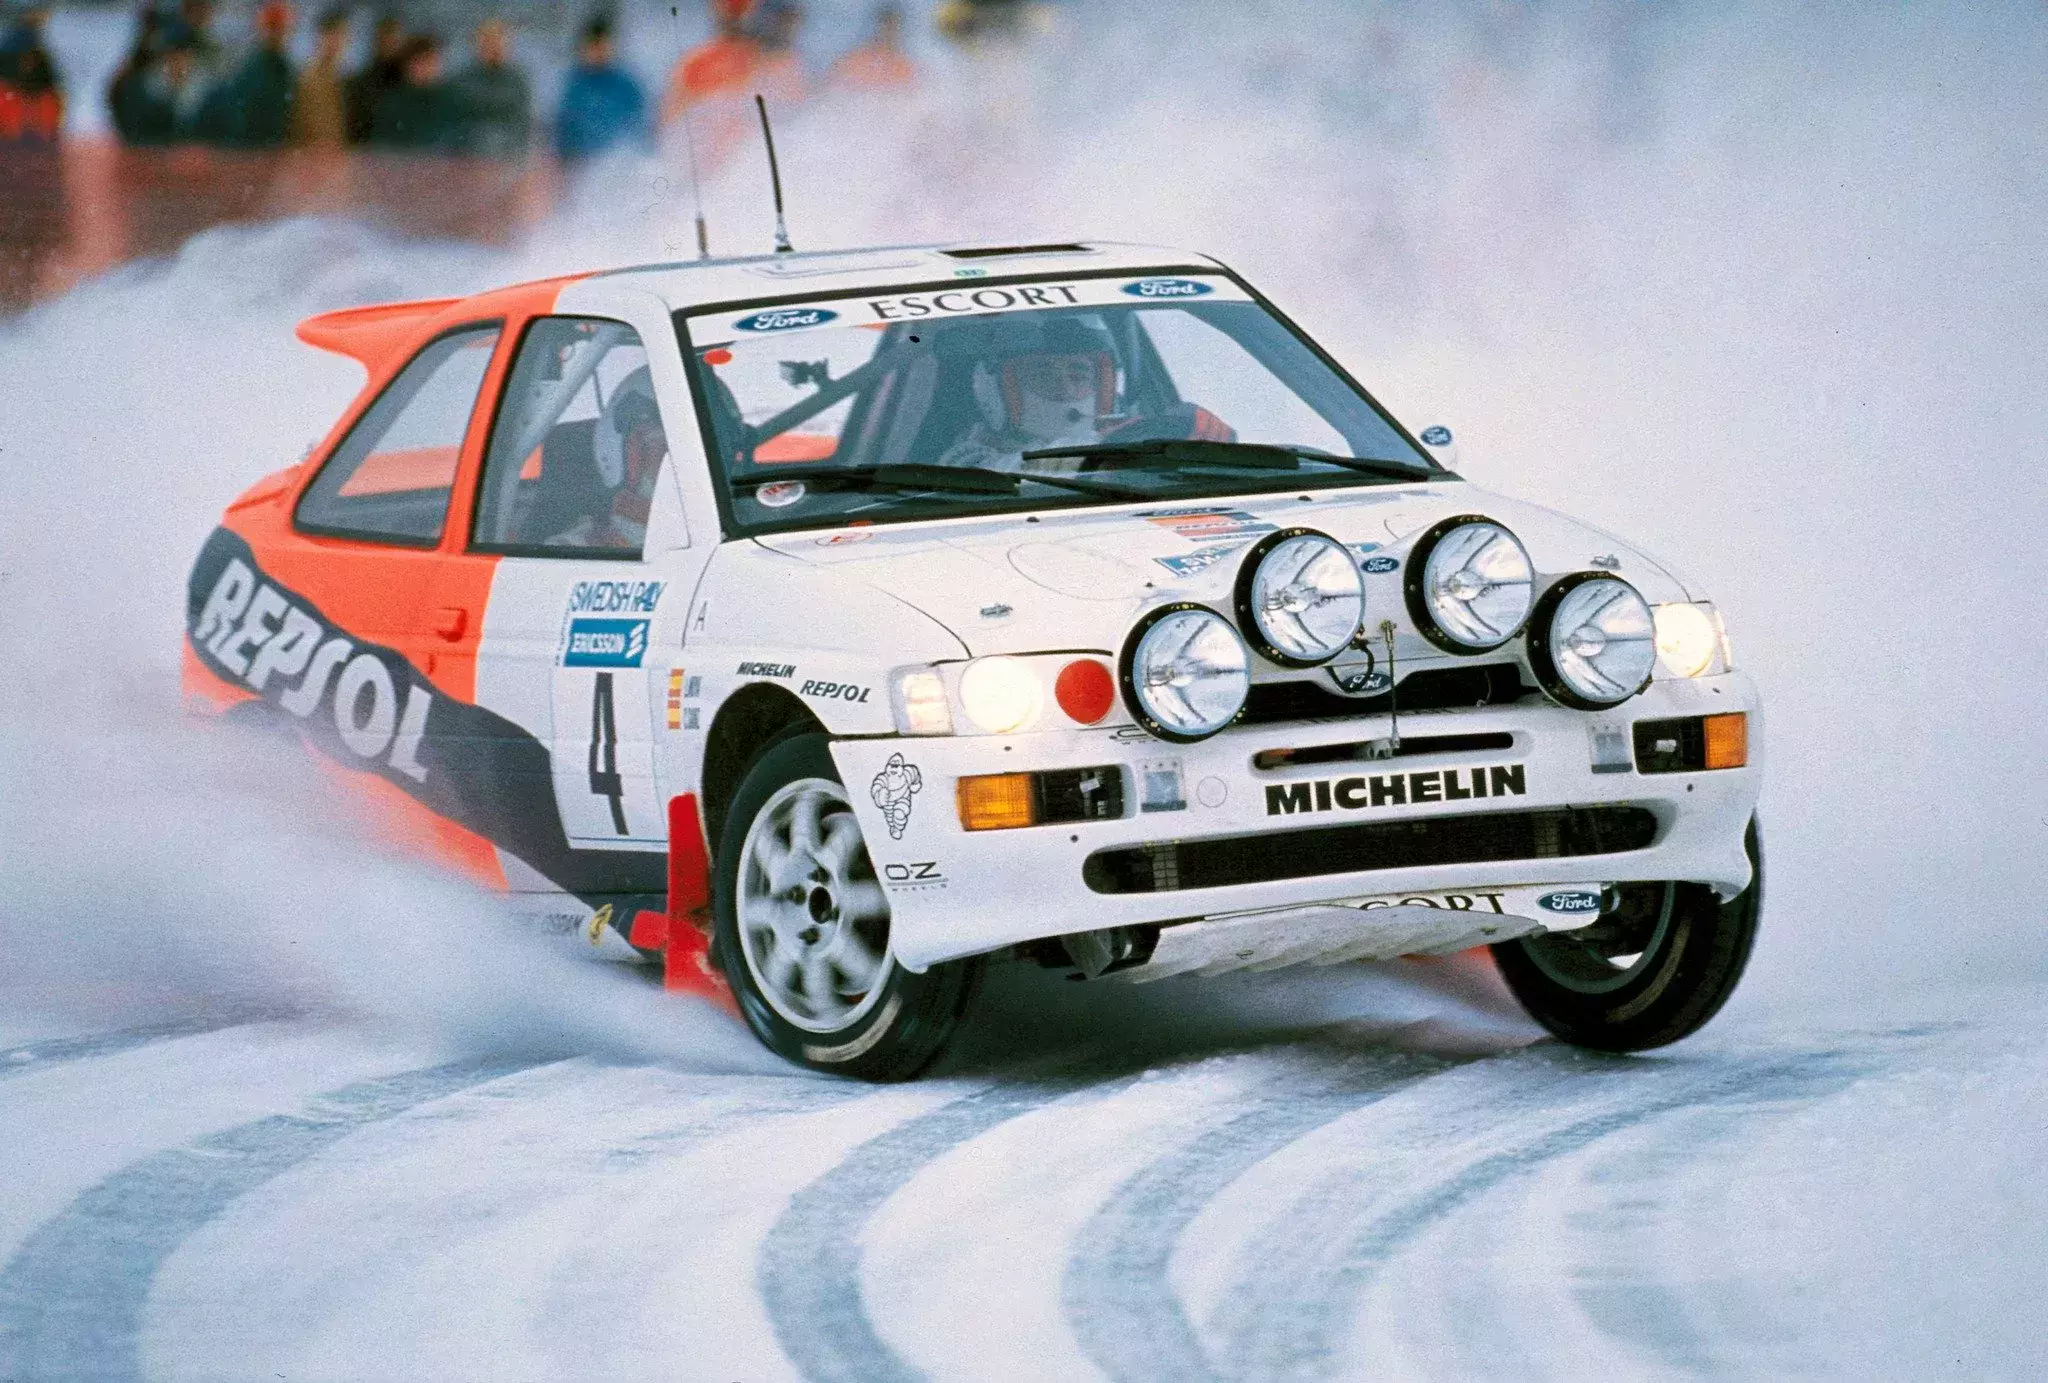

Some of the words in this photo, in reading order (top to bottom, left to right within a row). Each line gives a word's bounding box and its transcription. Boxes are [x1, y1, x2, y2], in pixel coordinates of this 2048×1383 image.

[1140, 279, 1197, 296] Ford
[867, 285, 1080, 320] ESCORT
[754, 310, 820, 330] Ford
[194, 557, 433, 784] REPSOL
[736, 661, 797, 679] MICHELIN
[800, 679, 872, 703] REPSOL
[588, 672, 630, 836] 4
[1265, 763, 1527, 816] MICHELIN
[1552, 893, 1596, 910] Ford
